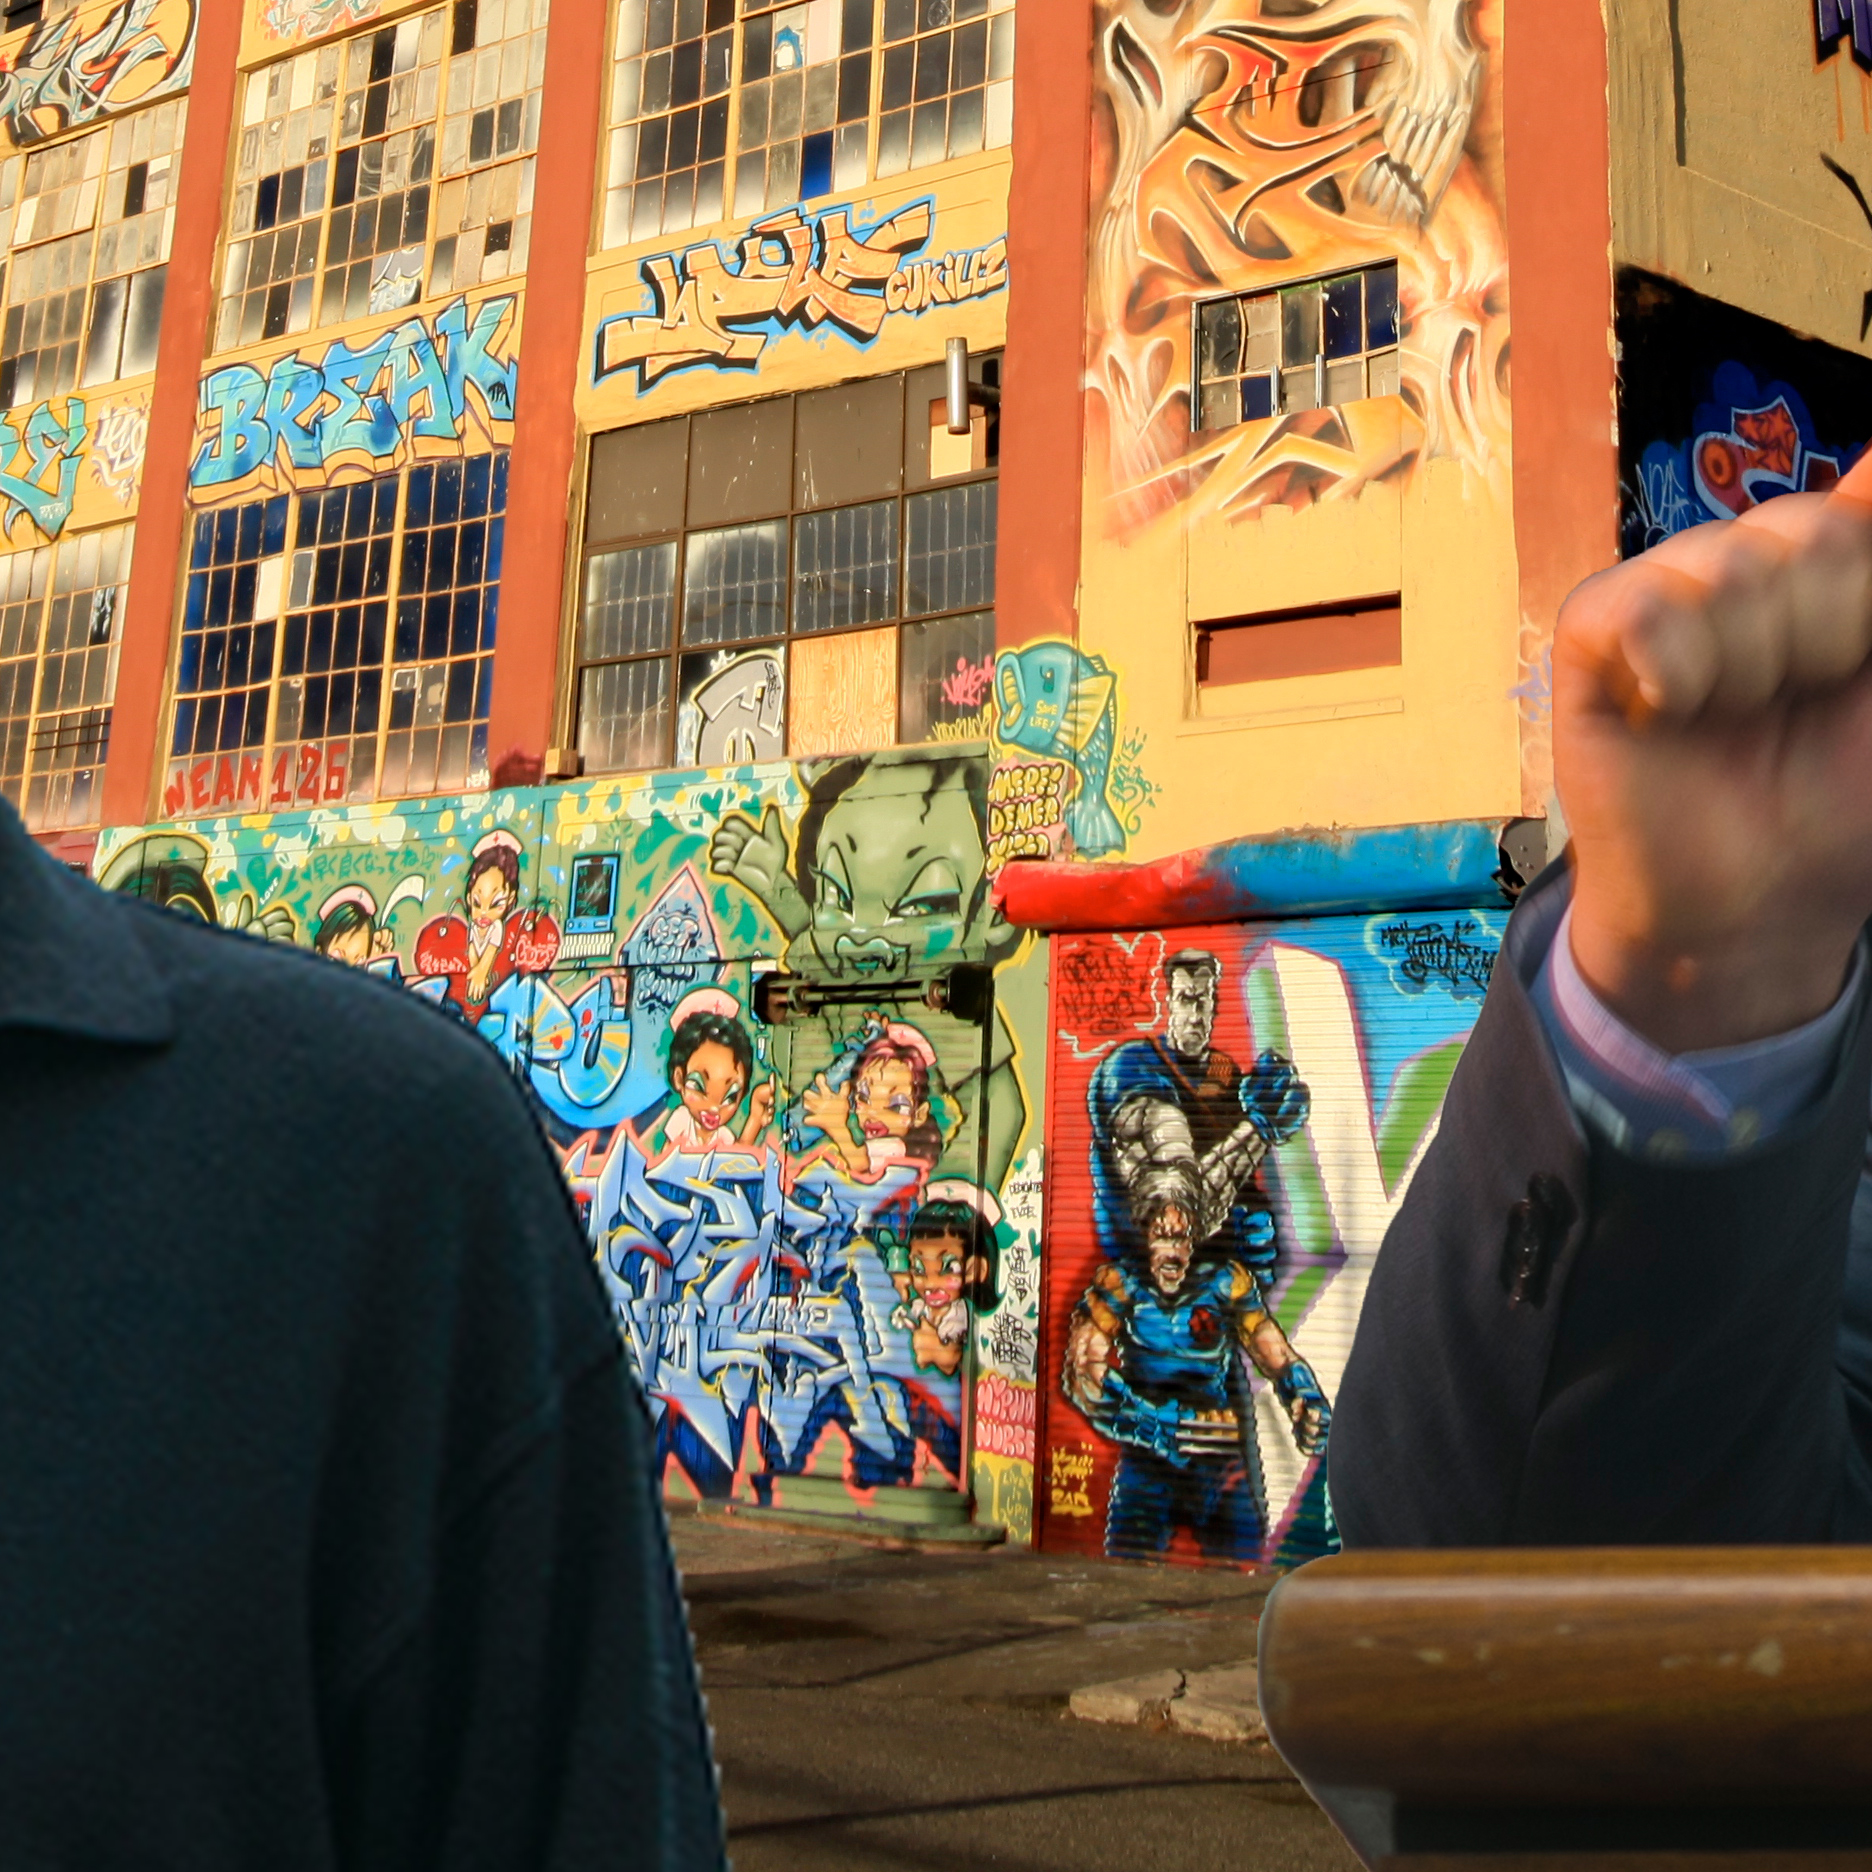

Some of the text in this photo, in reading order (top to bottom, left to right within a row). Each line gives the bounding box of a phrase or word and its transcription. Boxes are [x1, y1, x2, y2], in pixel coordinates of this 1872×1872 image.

[189, 294, 519, 500] BREAK
[1035, 699, 1060, 716] SAVE
[990, 795, 1061, 836] DEMER
[260, 878, 278, 905] LOVE
